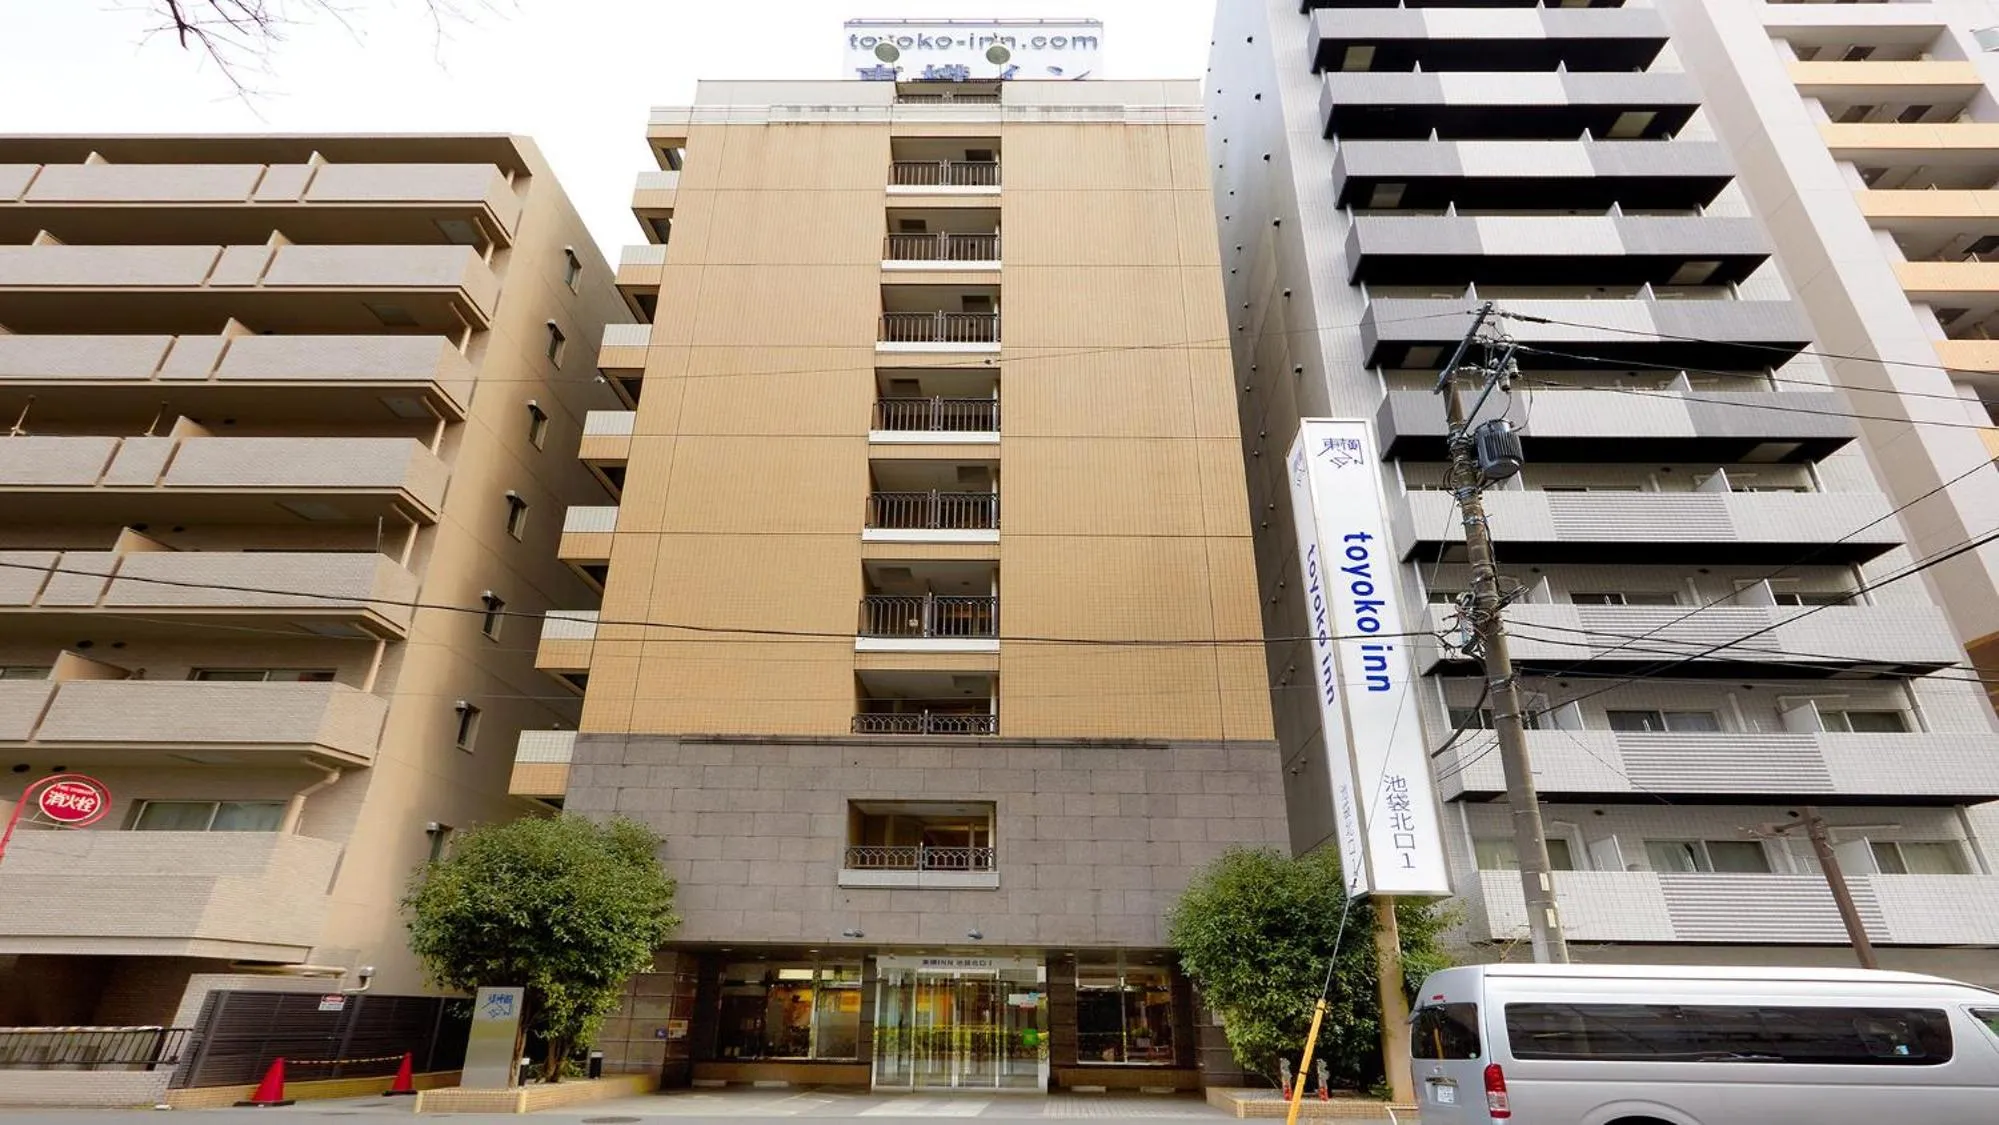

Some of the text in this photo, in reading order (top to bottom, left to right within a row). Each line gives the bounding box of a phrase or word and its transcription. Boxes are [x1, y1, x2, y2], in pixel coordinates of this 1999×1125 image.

[1307, 544, 1335, 705] toyoko inn
[1341, 532, 1393, 692] toyoko inn
[45, 790, 96, 812] 消火栓
